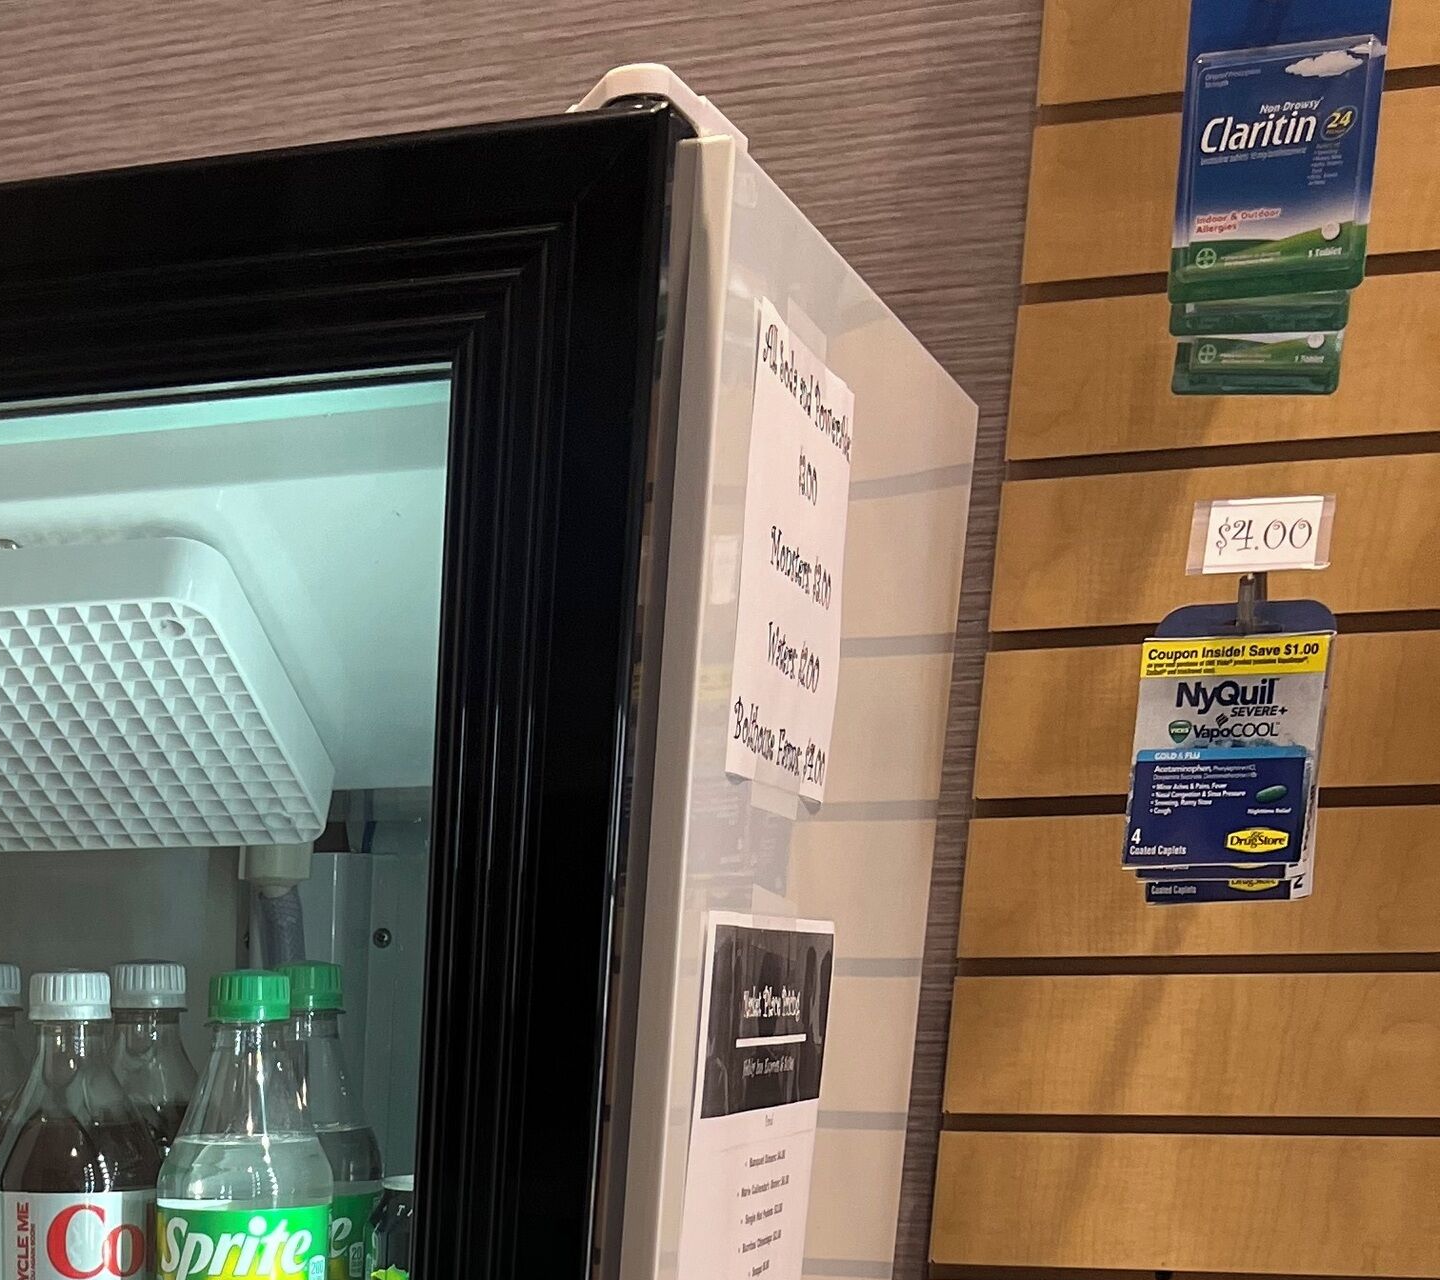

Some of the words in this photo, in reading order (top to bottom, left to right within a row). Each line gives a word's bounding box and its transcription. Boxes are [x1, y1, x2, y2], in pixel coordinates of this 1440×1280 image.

[1327, 110, 1353, 128] 24
[1200, 111, 1317, 154] Claritin
[1196, 214, 1227, 225] Indoor
[1230, 212, 1238, 221] &
[1241, 208, 1280, 220] Outdoor
[1196, 221, 1237, 234] Allergies
[1216, 517, 1312, 556] $4.00
[1148, 647, 1199, 662] Coupon
[1201, 645, 1246, 659] Inside!
[1249, 644, 1280, 656] Save
[1283, 643, 1319, 655] $1.00
[1176, 679, 1274, 715] NyQuil
[1193, 722, 1278, 743] VapoCOOL
[1154, 752, 1176, 760] COLD
[1184, 752, 1201, 760] FLU
[1131, 828, 1141, 844] 4
[1229, 836, 1258, 848] Drug
[1258, 835, 1286, 846] Store
[1129, 845, 1156, 855] Coated
[1157, 845, 1187, 856] Caplets
[17, 1201, 30, 1232] ME
[46, 1203, 156, 1280] Co
[311, 1260, 324, 1275] 200
